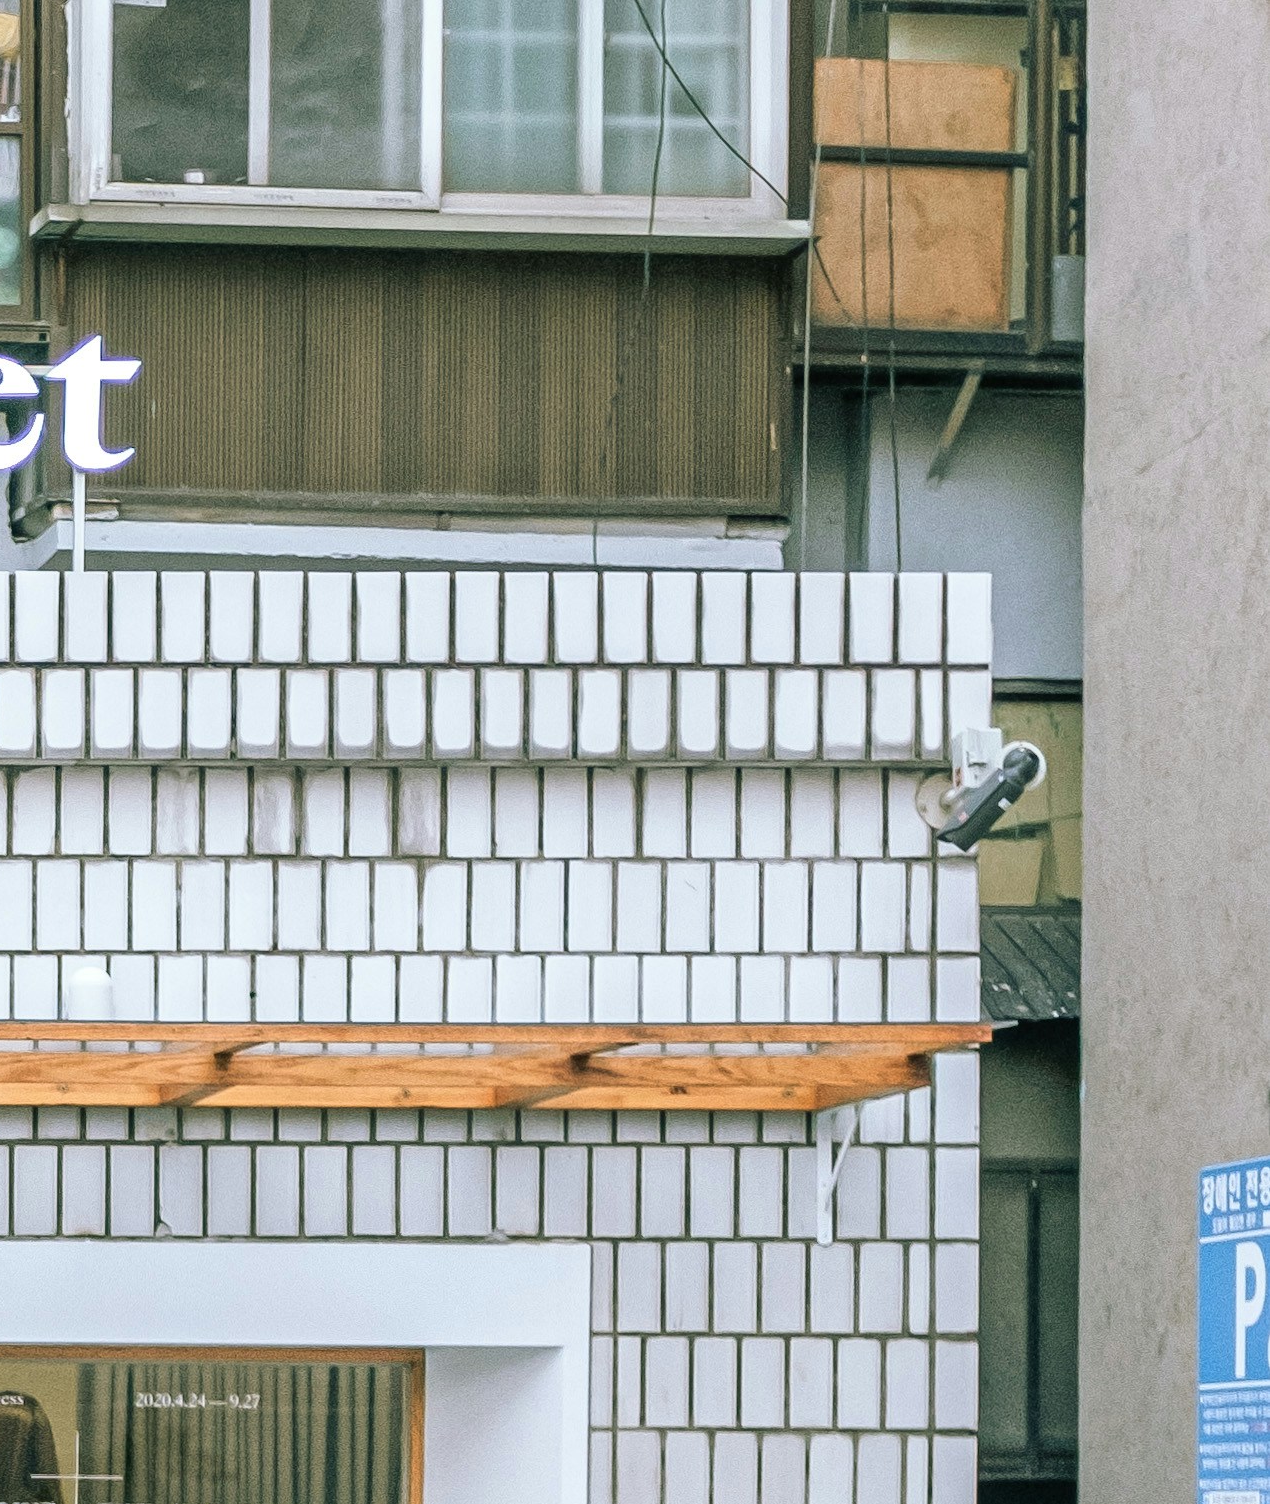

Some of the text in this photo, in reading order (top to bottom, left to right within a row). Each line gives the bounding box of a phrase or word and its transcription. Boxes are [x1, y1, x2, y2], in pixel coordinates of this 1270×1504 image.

[1202, 1170, 1241, 1215] 장애인
[1235, 1241, 1266, 1379] P
[135, 1392, 206, 1408] 2020.4.24
[229, 1393, 260, 1410] 9.27
